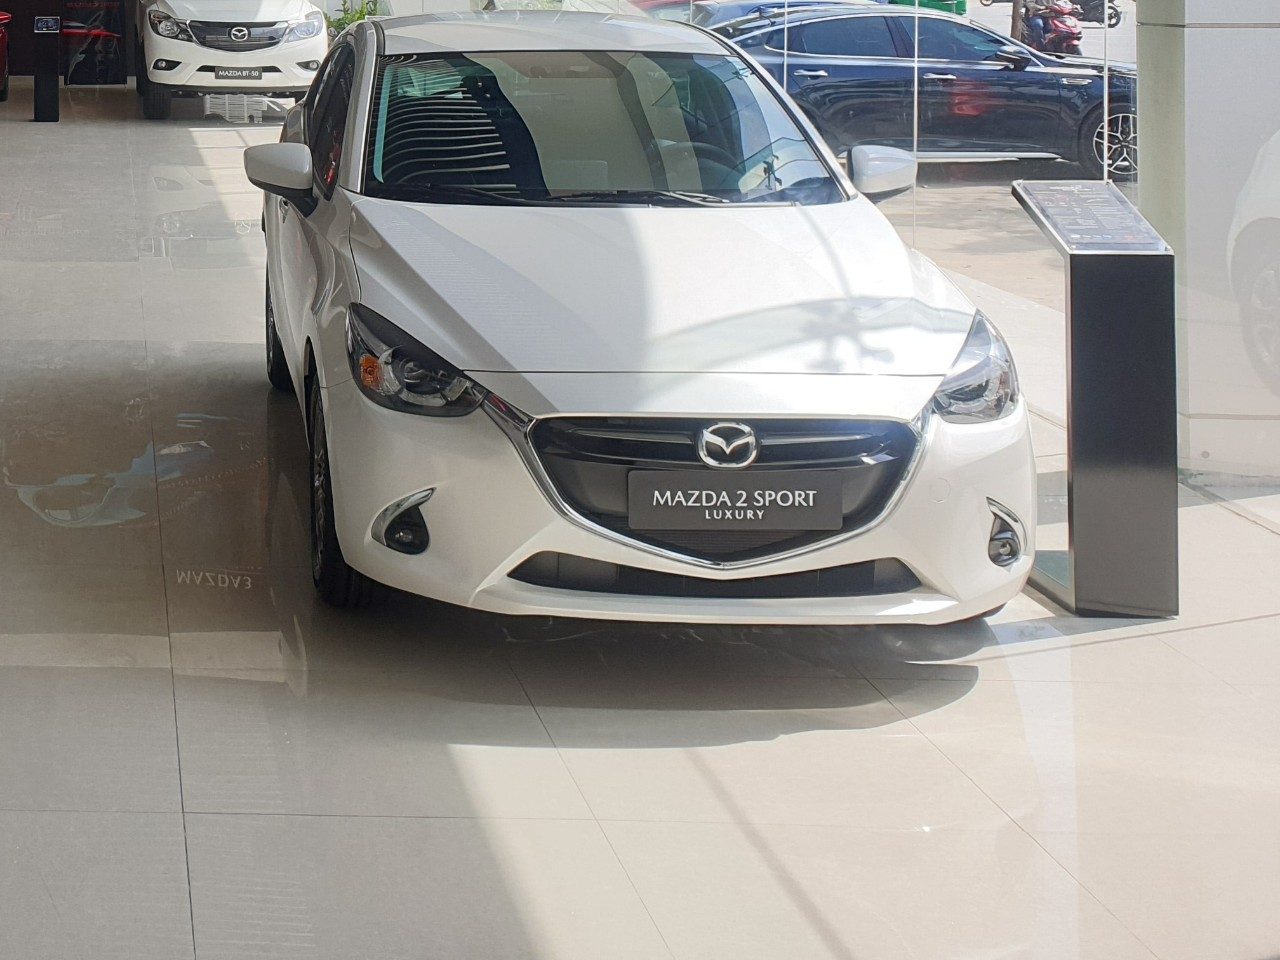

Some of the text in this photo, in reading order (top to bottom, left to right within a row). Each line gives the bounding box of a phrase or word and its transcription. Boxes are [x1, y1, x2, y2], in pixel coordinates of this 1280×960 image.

[652, 490, 817, 507] MAZDA 2 SPORT
[705, 509, 765, 520] LUXURY
